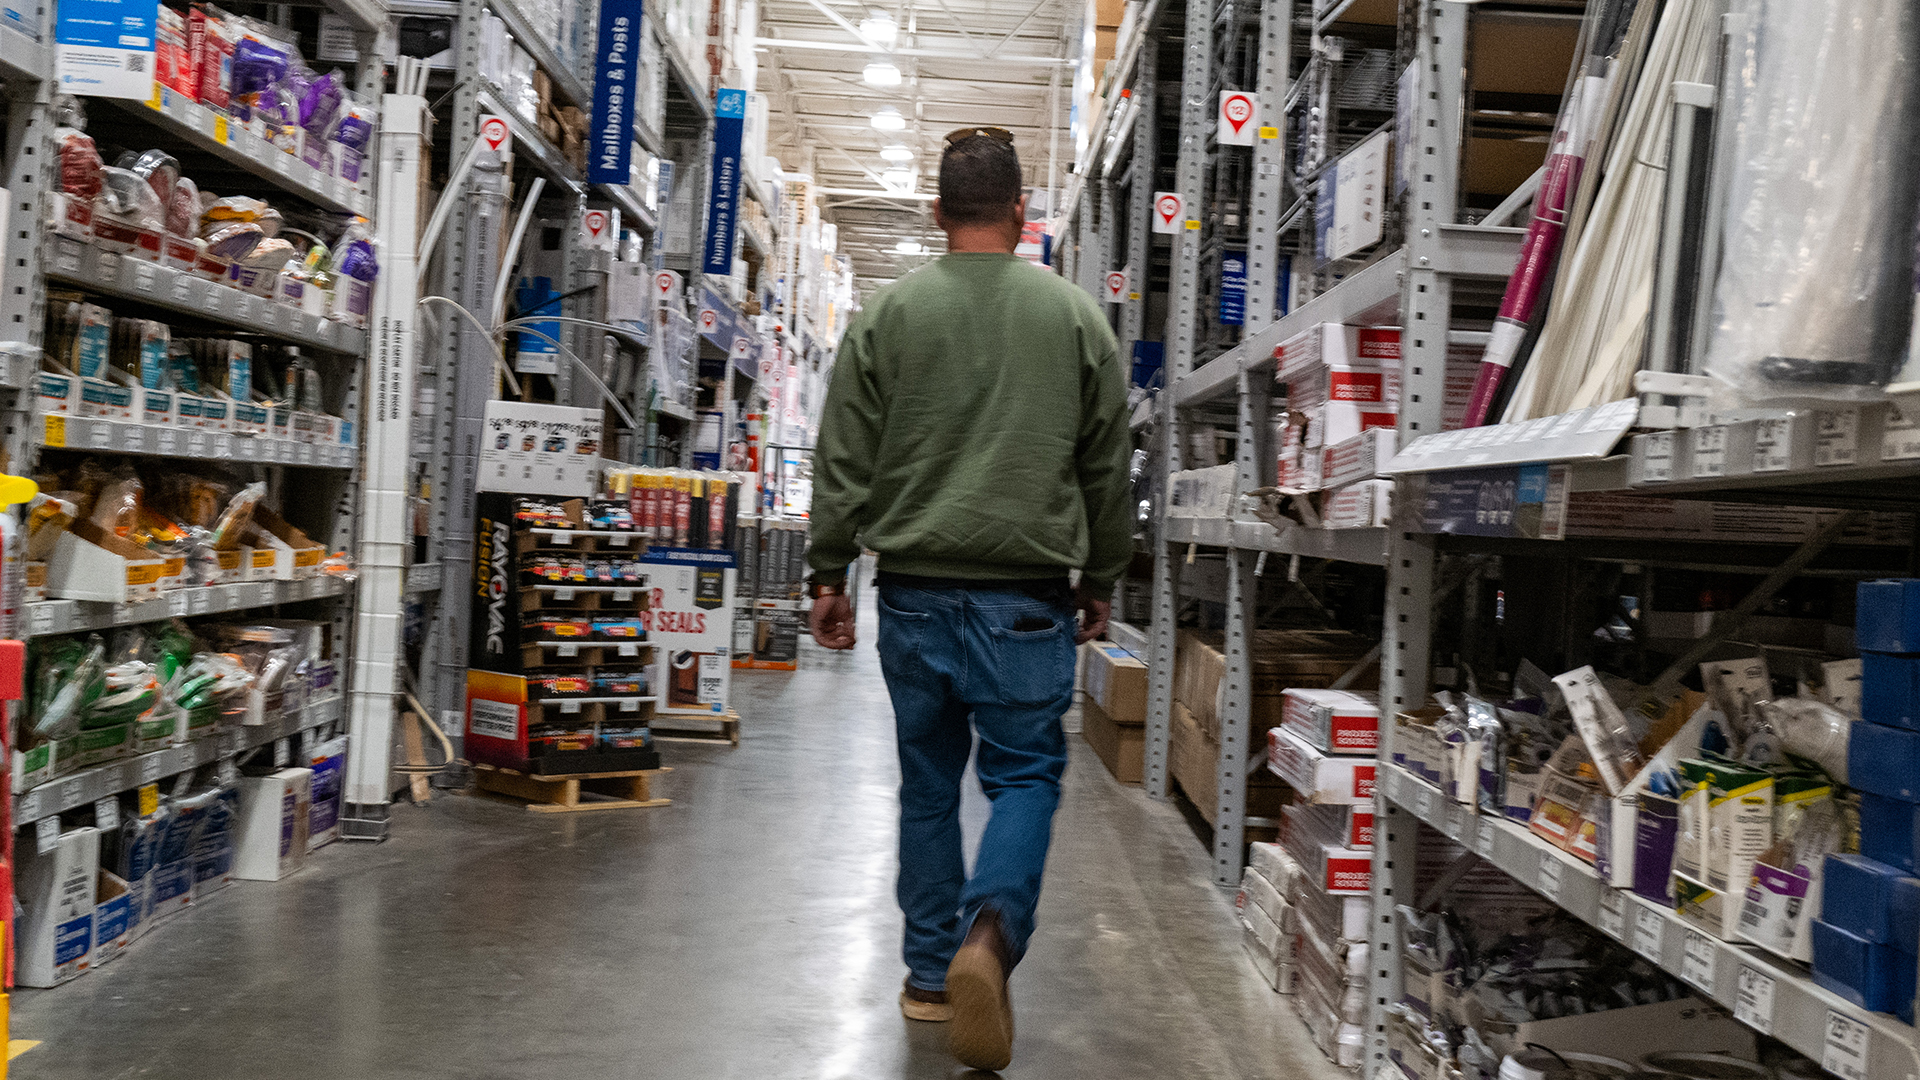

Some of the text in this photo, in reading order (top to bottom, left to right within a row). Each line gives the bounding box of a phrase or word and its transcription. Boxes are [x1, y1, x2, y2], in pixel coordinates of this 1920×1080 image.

[600, 16, 630, 170] Mailboxes & Posts
[711, 156, 735, 266] Numbers & Letters
[1335, 391, 1374, 399] SOURCE
[1336, 384, 1376, 392] PROJECT
[477, 517, 493, 599] FUSION
[486, 521, 510, 654] RAYOVAC
[657, 611, 707, 634] SEALS
